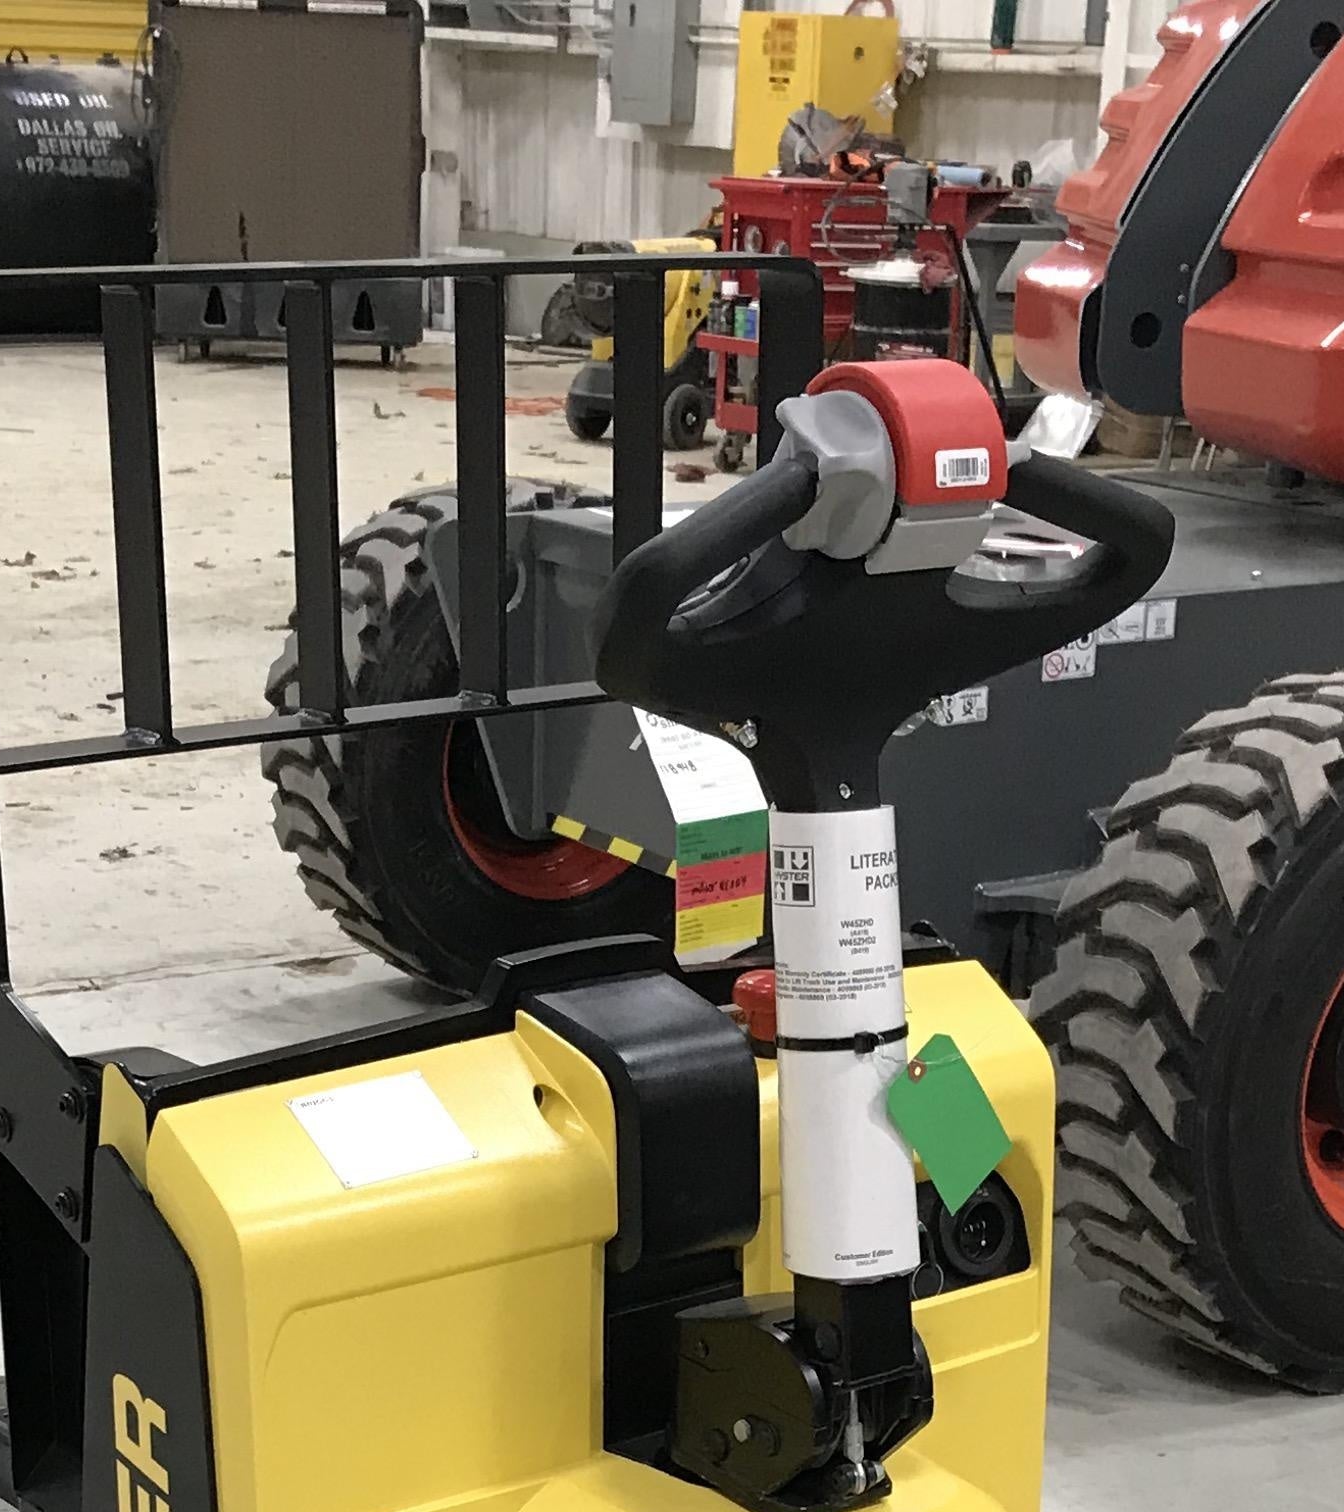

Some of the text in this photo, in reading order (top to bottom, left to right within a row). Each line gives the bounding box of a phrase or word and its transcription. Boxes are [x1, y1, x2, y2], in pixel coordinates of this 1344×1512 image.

[15, 91, 113, 109] USED OIL
[17, 119, 123, 139] DALLAS OIL
[37, 138, 110, 157] SERVICE
[865, 872, 898, 891] PACK
